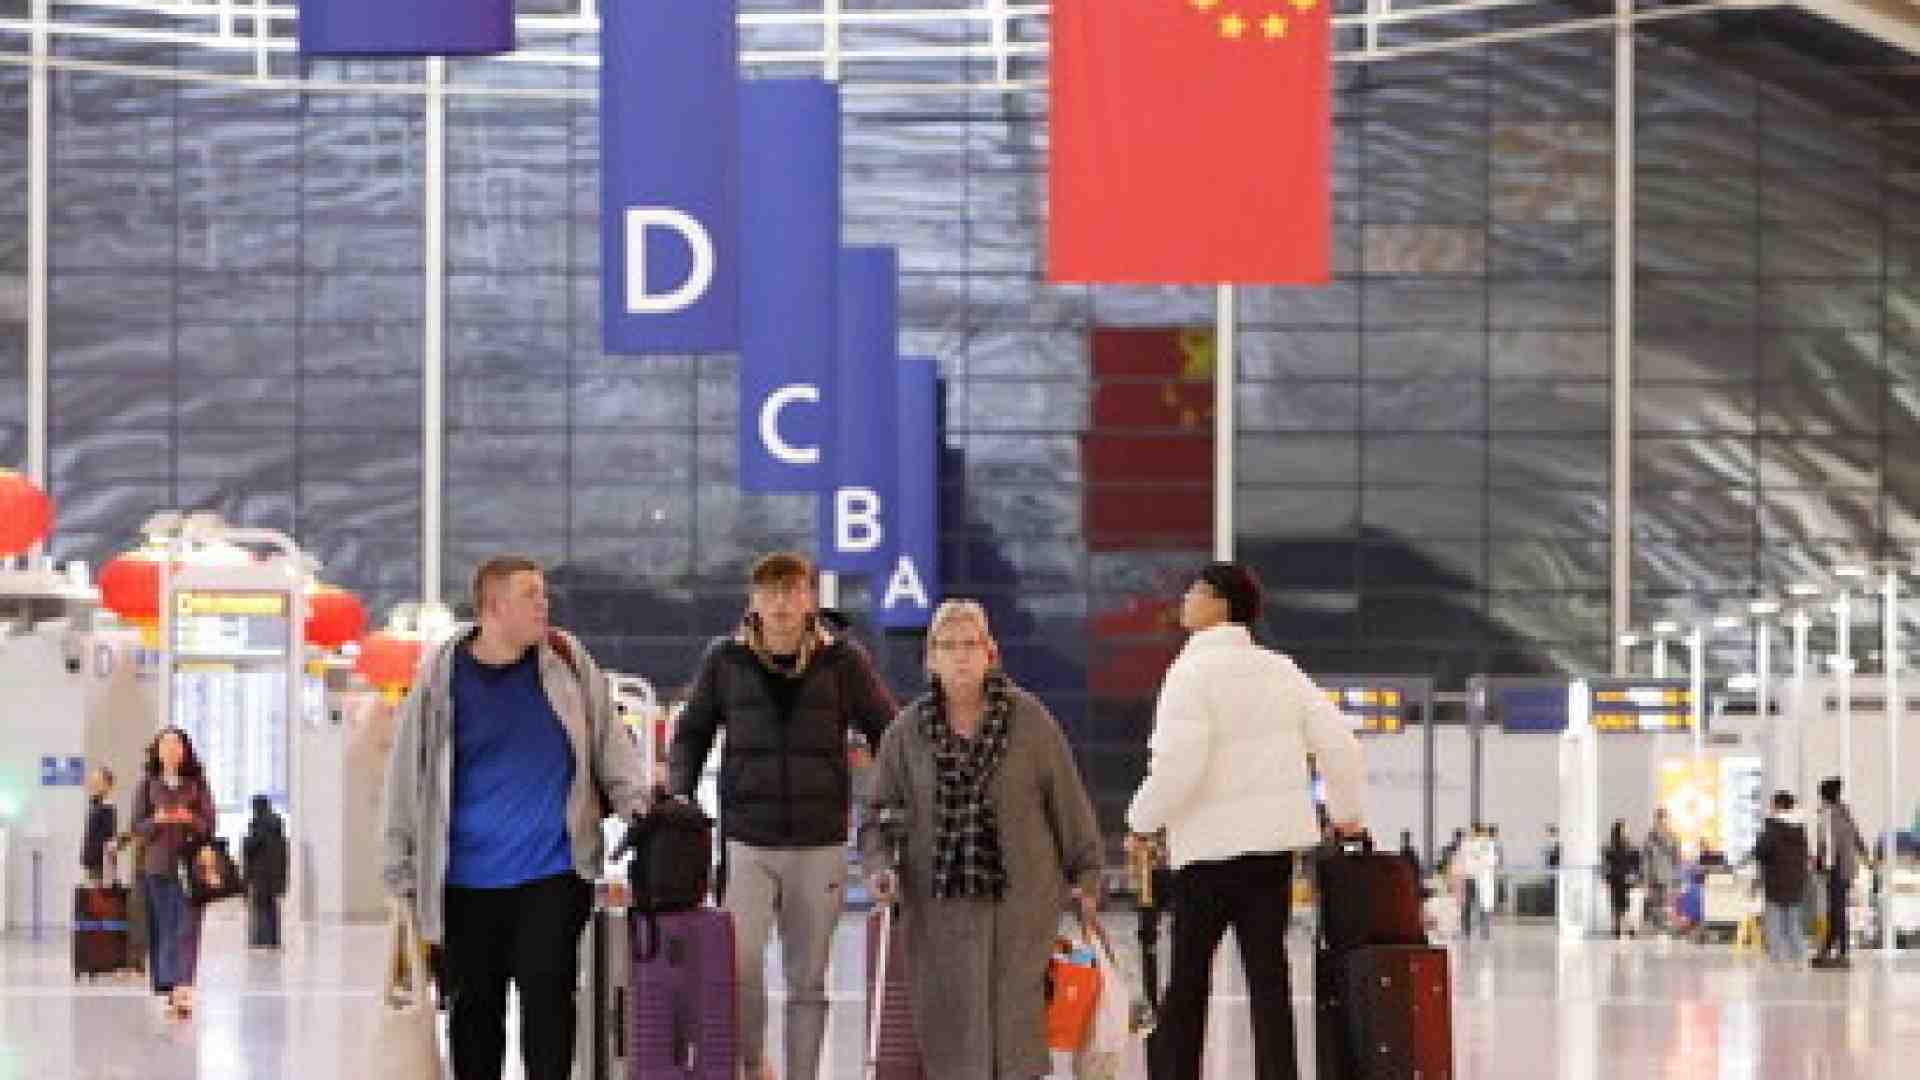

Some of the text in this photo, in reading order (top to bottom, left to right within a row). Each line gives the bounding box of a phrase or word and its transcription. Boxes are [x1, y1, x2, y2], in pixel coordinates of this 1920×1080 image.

[625, 207, 715, 313] D
[759, 384, 821, 464] C
[835, 487, 882, 552] B
[884, 556, 929, 608] A
